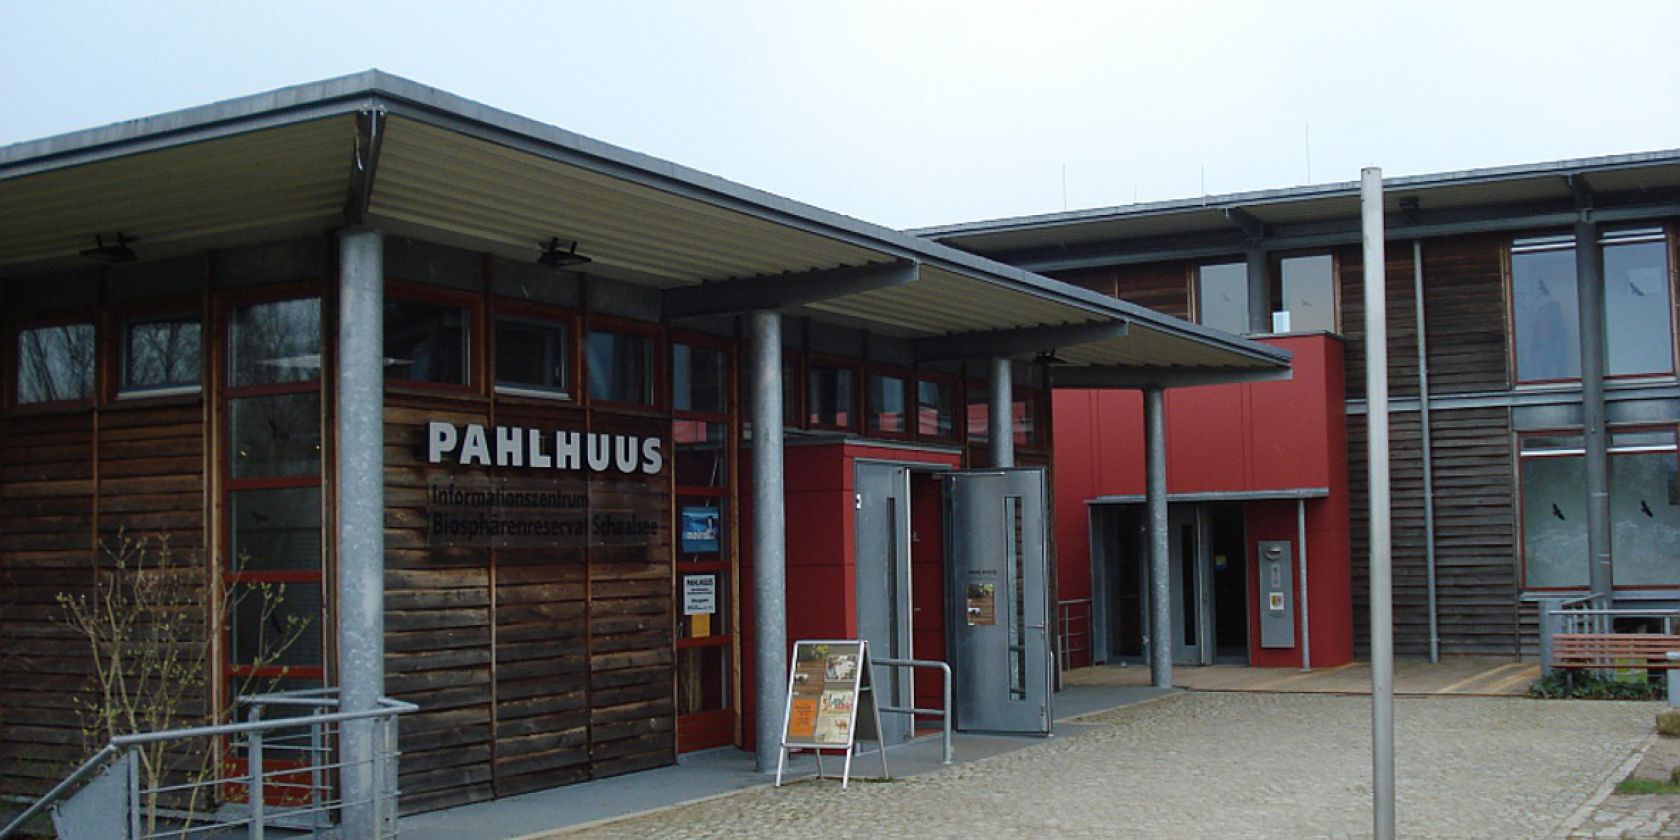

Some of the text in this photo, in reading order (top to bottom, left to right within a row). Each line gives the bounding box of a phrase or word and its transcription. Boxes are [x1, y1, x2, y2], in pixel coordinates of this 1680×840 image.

[429, 421, 663, 475] PAHLHUUS
[432, 483, 588, 506] Informationszentrum
[432, 511, 659, 540] Biosphärenreservat Schaalsee
